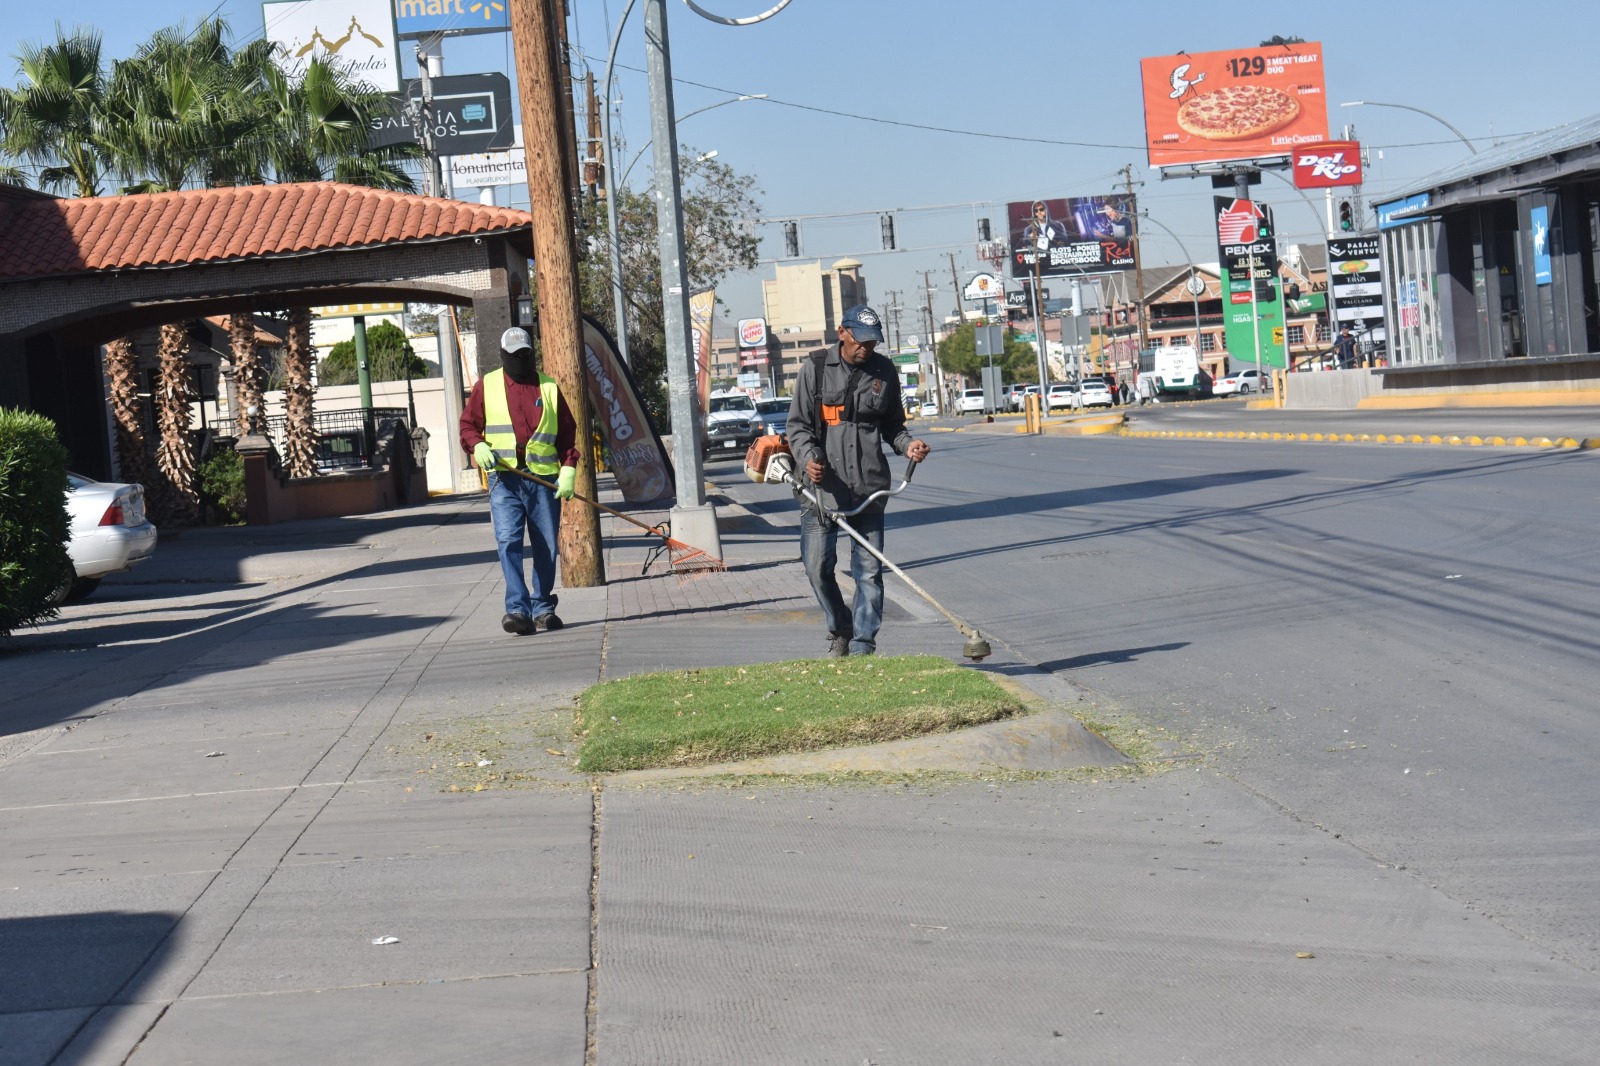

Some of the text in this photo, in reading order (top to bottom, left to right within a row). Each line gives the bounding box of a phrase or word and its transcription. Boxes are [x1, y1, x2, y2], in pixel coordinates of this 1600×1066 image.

[1272, 56, 1293, 65] MEAT
[1293, 54, 1318, 63] TREAT
[1226, 56, 1266, 78] $129
[1270, 133, 1323, 146] Little Caesars
[1297, 152, 1344, 166] Del
[1311, 163, 1358, 180] Rio
[1049, 246, 1073, 254] SLOTS
[1076, 244, 1101, 252] POKER
[1101, 240, 1132, 263] Red
[1225, 243, 1271, 256] PEMEX
[1347, 241, 1378, 249] PASAJE
[1050, 250, 1101, 260] RESTAURANTE
[1112, 257, 1134, 265] CASINO
[743, 328, 763, 341] KING
